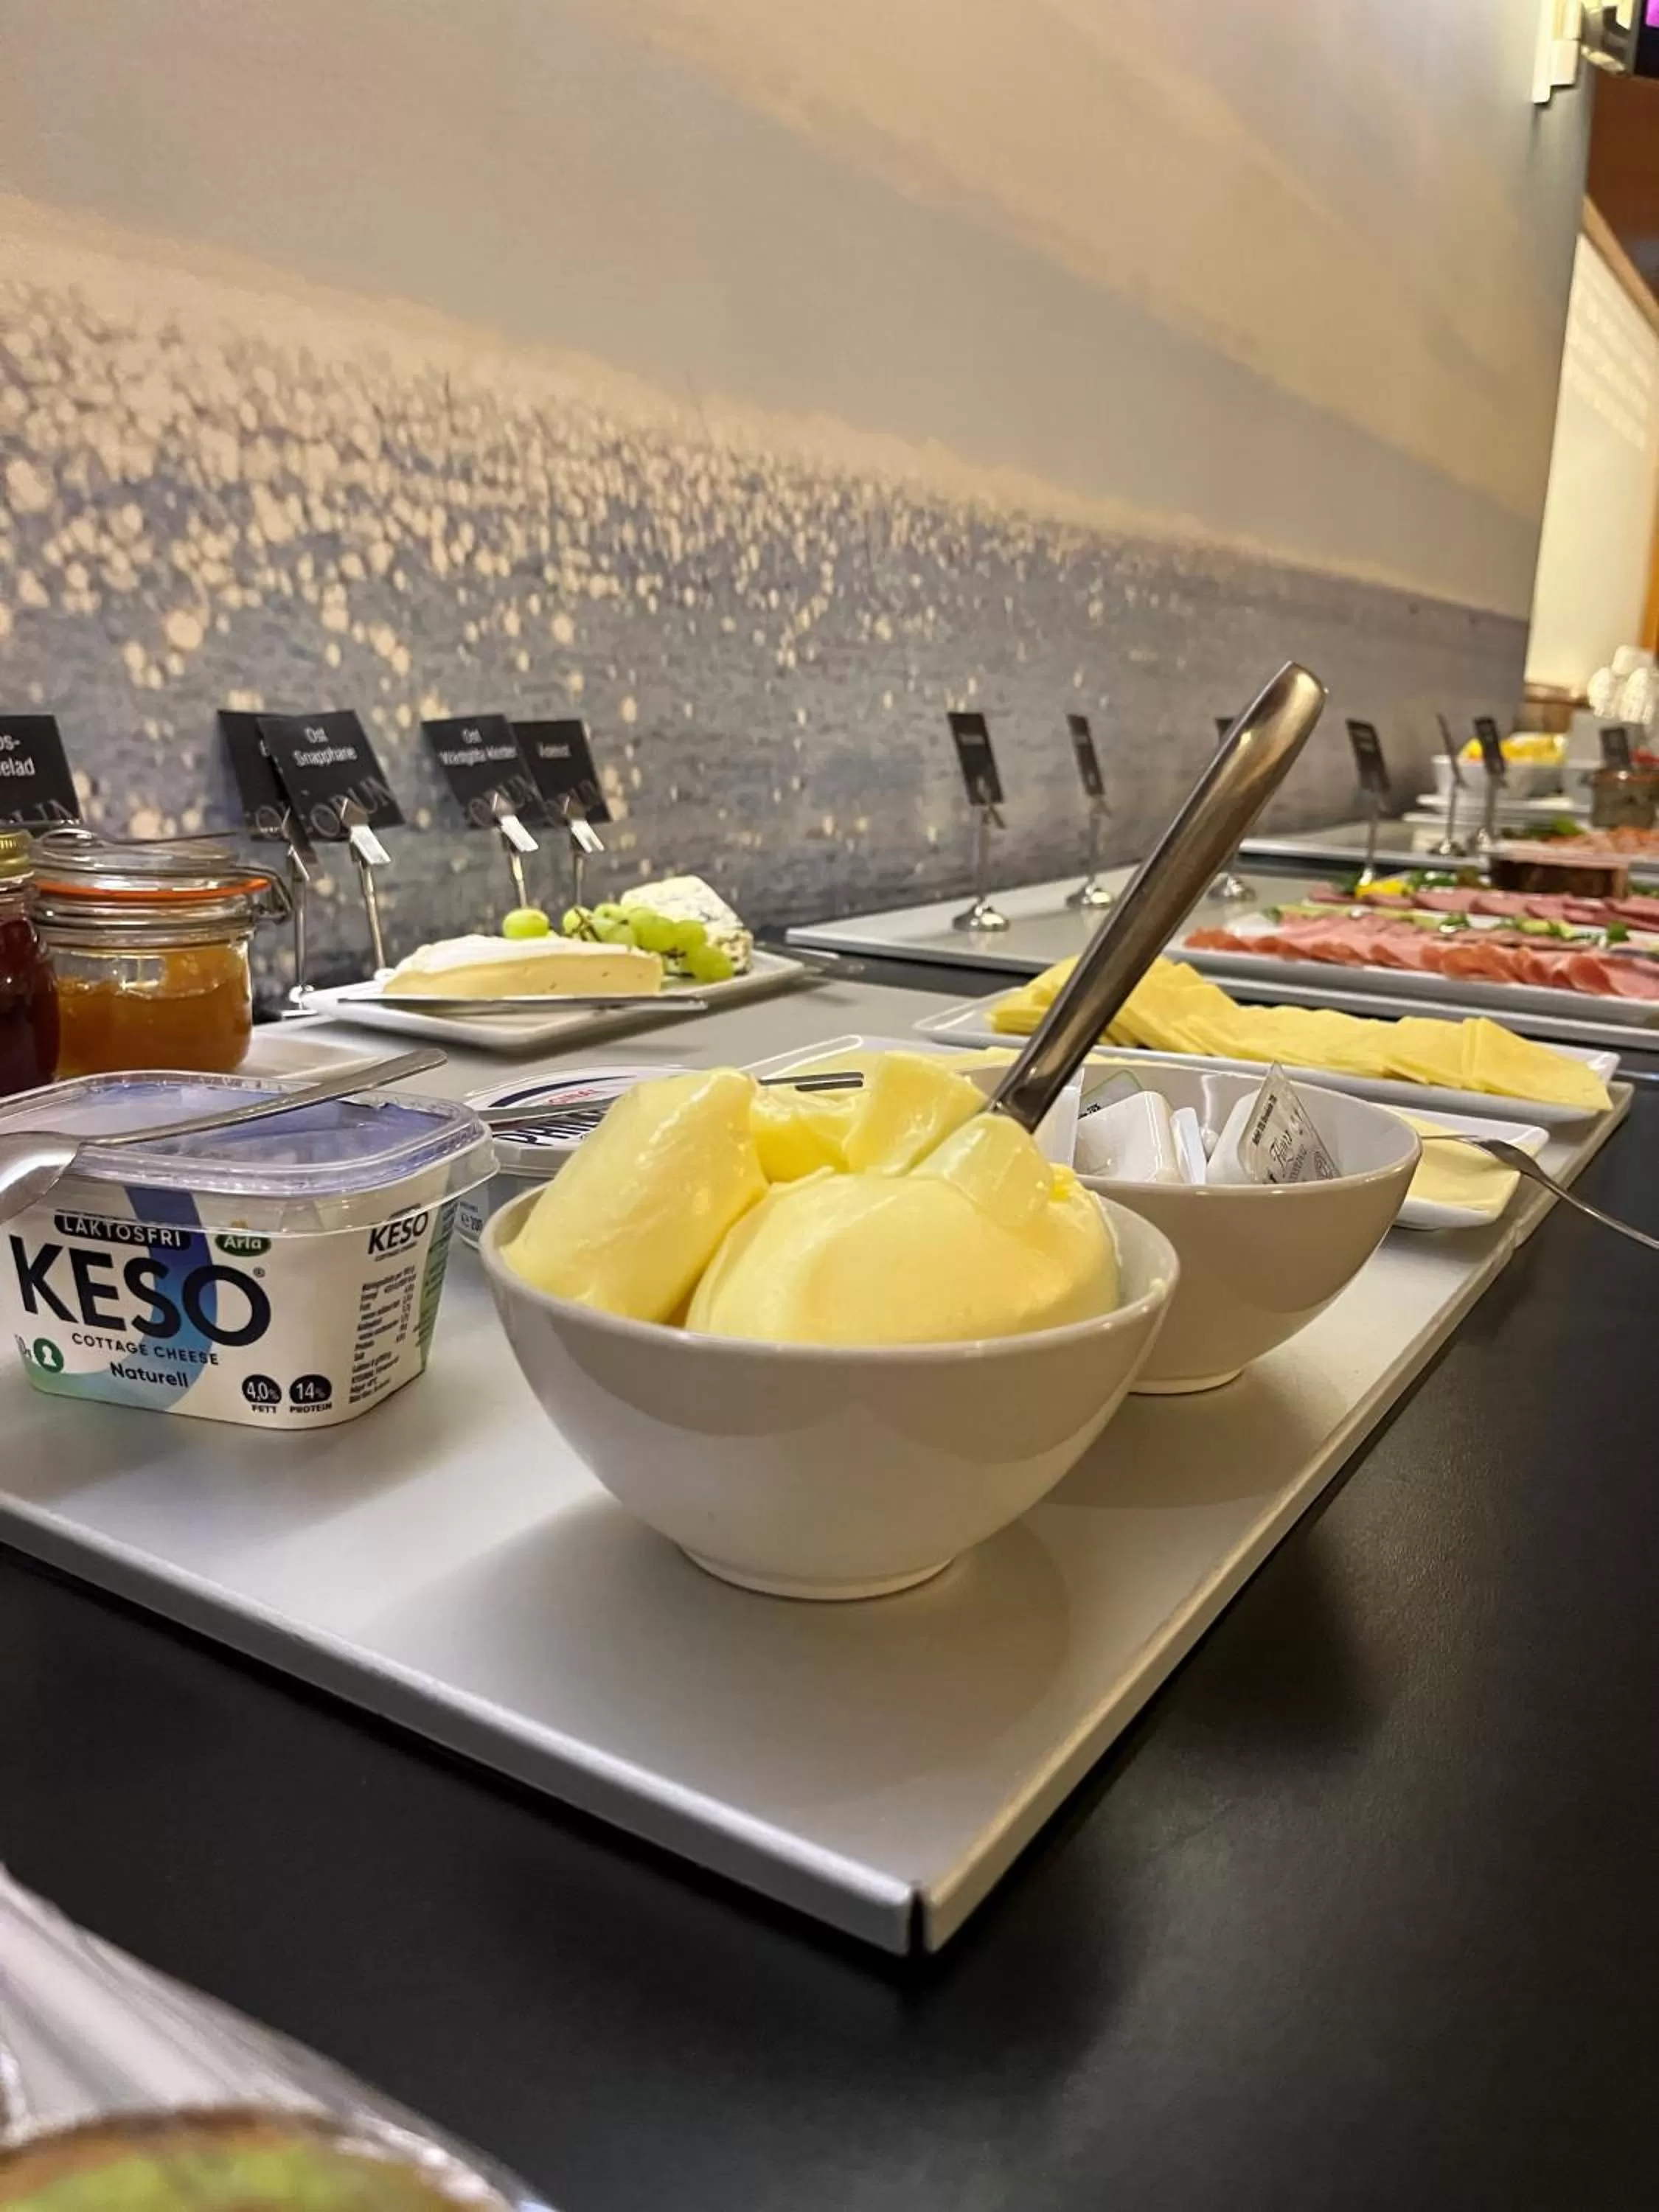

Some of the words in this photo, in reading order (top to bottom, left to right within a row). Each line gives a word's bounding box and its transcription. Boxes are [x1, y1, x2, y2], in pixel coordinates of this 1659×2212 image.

[63, 1215, 181, 1247] LAKTOSFRI
[223, 1235, 262, 1249] Arla
[368, 1211, 428, 1254] KESO
[9, 1234, 271, 1346] KESO
[72, 1332, 148, 1356] COTTAGE
[154, 1346, 219, 1366] CHEESE
[110, 1362, 189, 1388] Naturell
